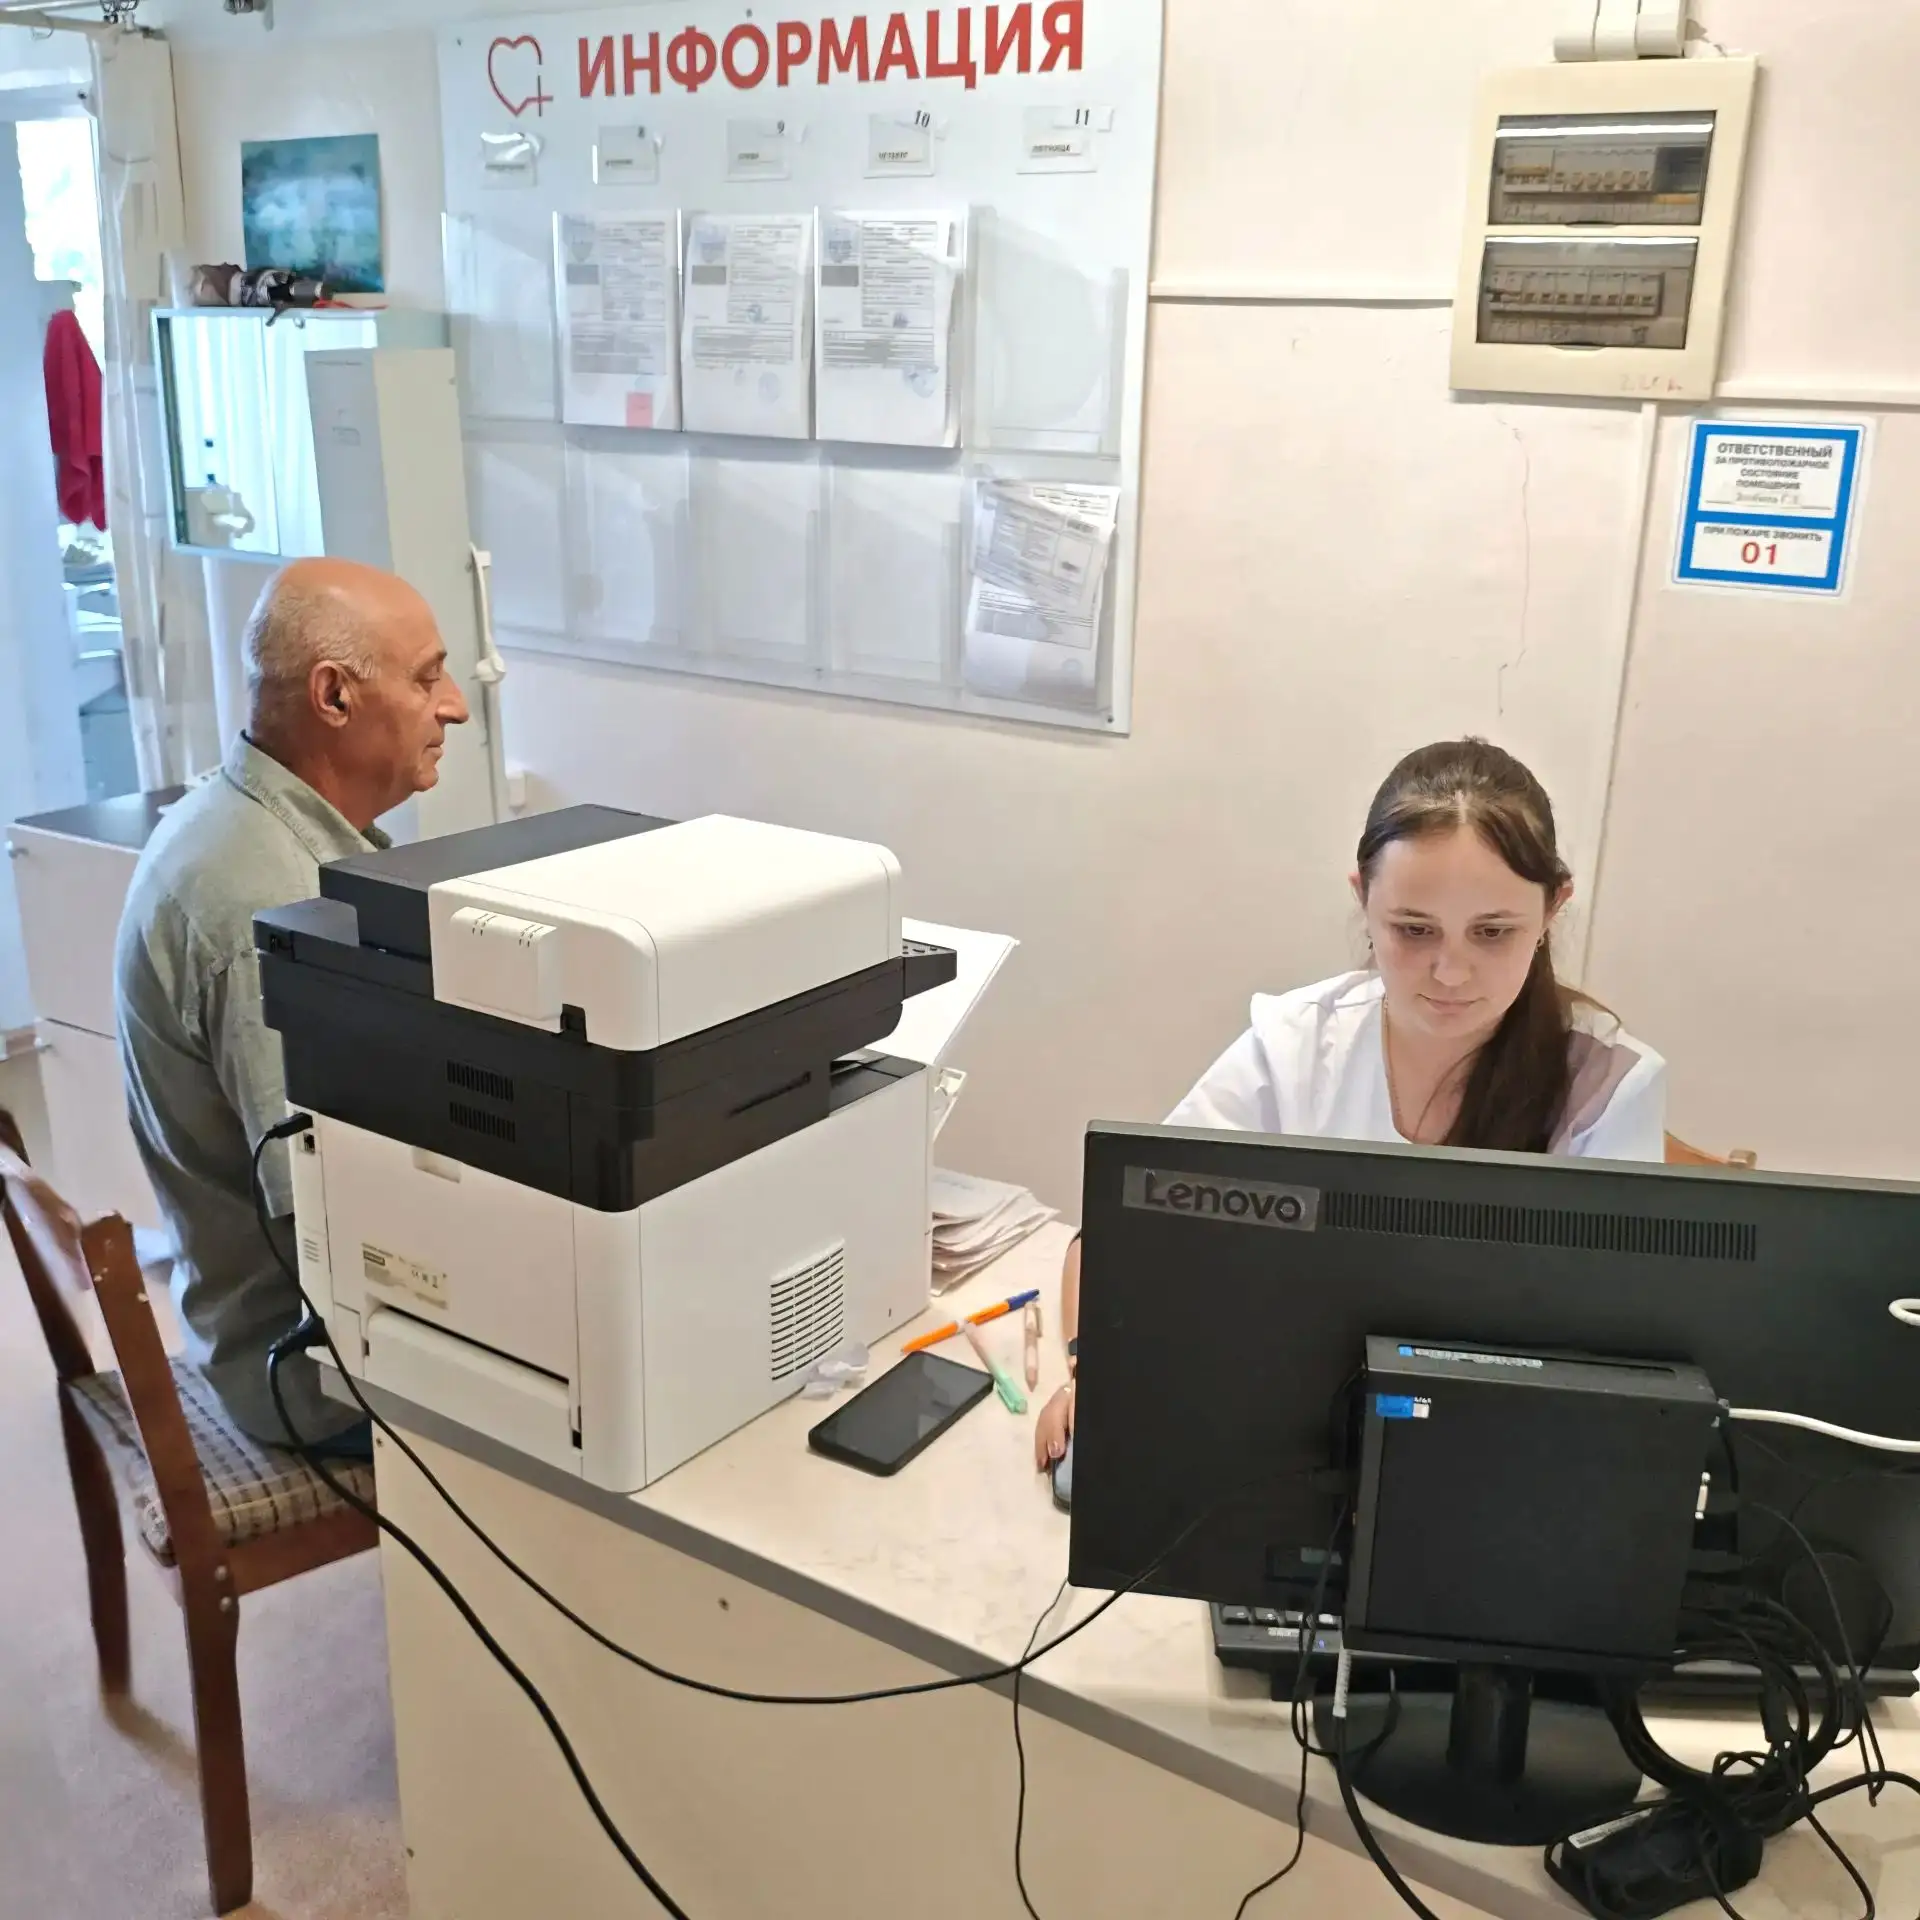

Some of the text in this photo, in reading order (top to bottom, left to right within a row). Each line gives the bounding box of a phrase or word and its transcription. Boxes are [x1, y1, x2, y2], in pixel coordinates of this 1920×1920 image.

[578, 0, 1084, 99] ИНФОРМАЦИЯ
[914, 109, 931, 128] 10
[1717, 442, 1833, 457] ОТВЕТСТВЕННЫЙ
[1726, 527, 1770, 539] ПОЖАРЕ
[1773, 530, 1823, 542] ЗВОНИТЬ
[1741, 541, 1777, 565] 01
[1144, 1168, 1301, 1223] Lenovo
